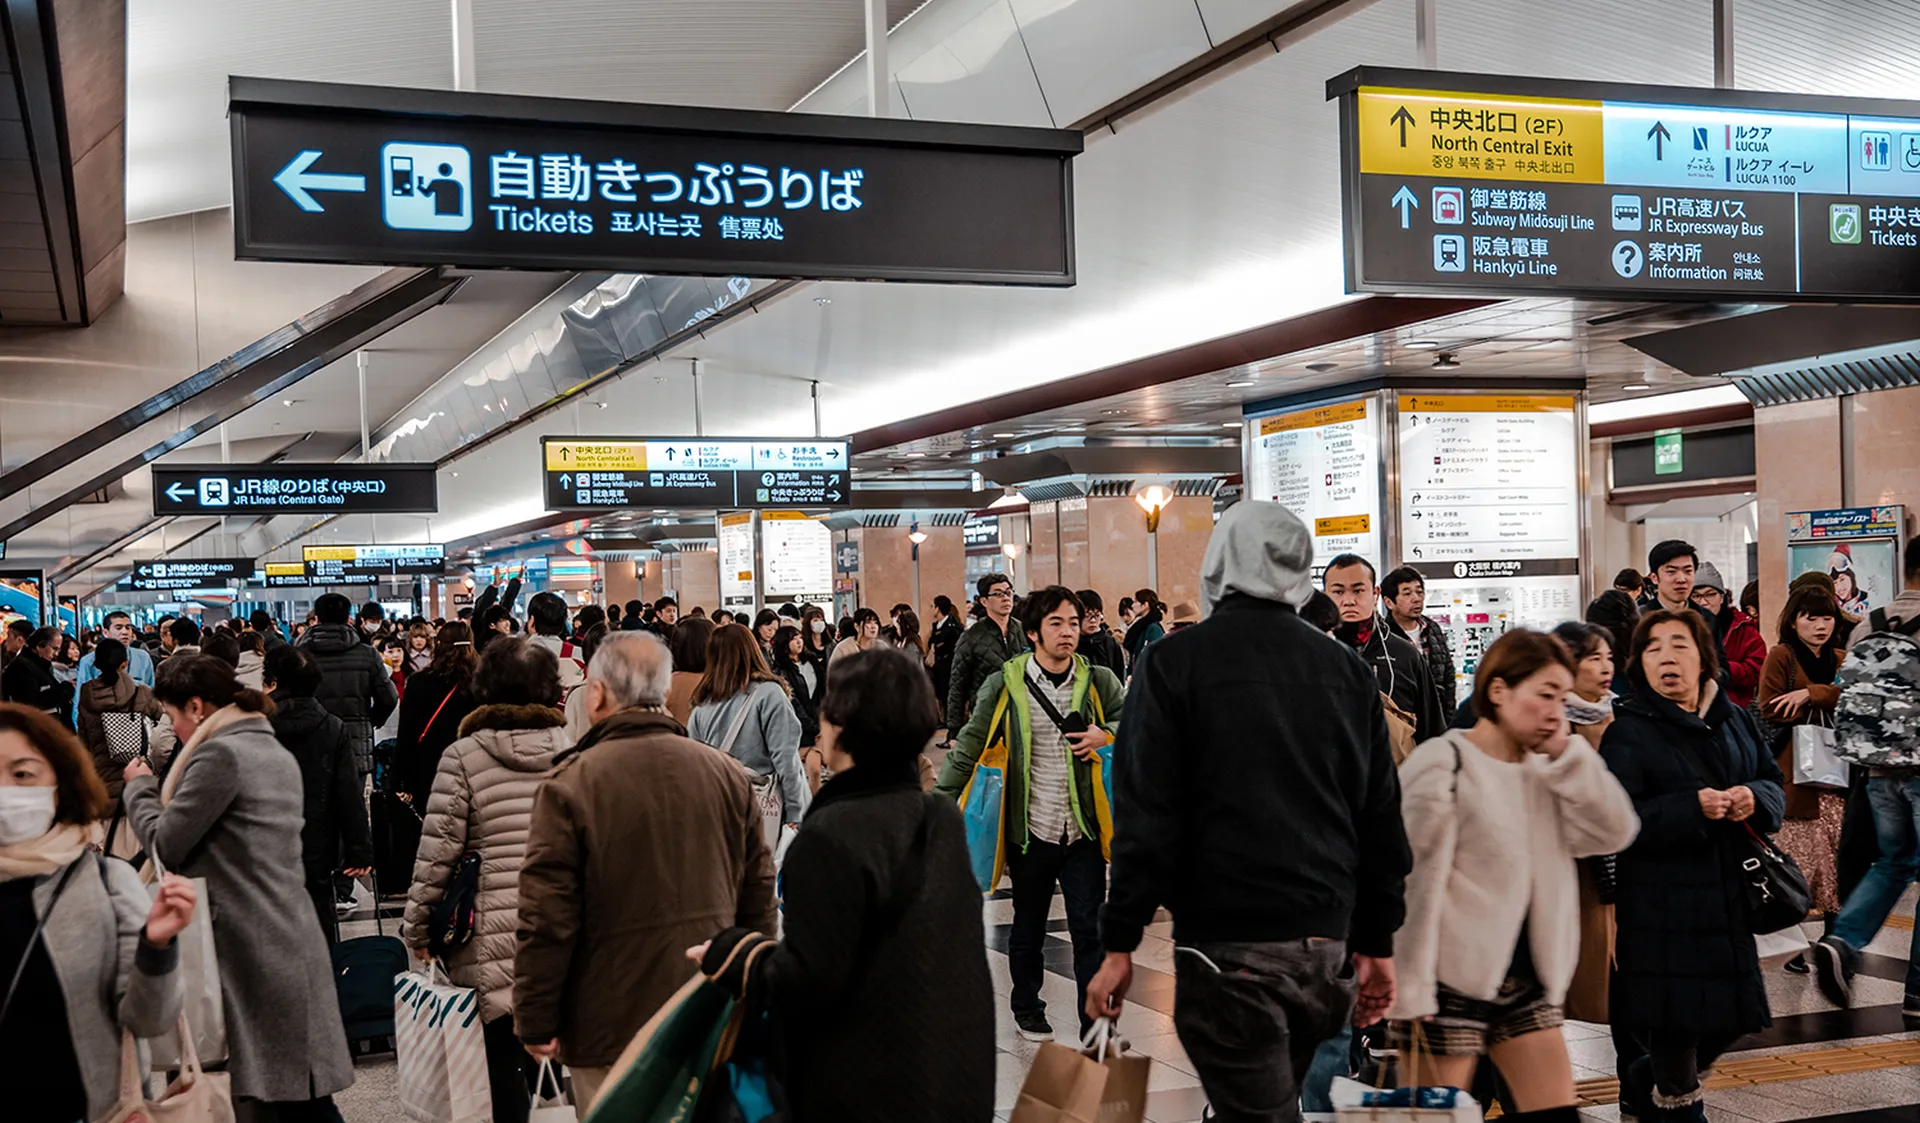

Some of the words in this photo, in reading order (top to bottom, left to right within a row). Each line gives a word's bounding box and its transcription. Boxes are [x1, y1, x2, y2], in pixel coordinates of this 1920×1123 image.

[1430, 107, 1517, 133] 中央北口
[1525, 116, 1564, 136] (2F)
[1735, 125, 1772, 140] ルクア
[1431, 135, 1478, 151] North
[1482, 138, 1539, 155] Central
[1544, 141, 1573, 156] Exit
[1735, 141, 1770, 152] LUCUA
[1431, 155, 1454, 169] 중앙
[1514, 159, 1575, 174] 中央北出口
[1736, 157, 1773, 171] ルクア
[1778, 161, 1815, 174] イーレ
[488, 150, 865, 211] 自動きっぷうりば
[1736, 173, 1770, 185] LUCUA
[1772, 174, 1796, 186] 1100
[1470, 187, 1547, 211] 御堂筋線
[1648, 197, 1747, 219] JR高速バス
[488, 204, 594, 235] Tickets
[610, 212, 702, 238] 표사는곳
[718, 215, 785, 241] 售票处
[1471, 210, 1516, 231] Subway
[1519, 213, 1568, 232] Midōsuji
[1570, 214, 1595, 231] Line
[1648, 219, 1663, 232] JR
[1666, 219, 1739, 239] Expressway
[1741, 221, 1764, 236] Bus
[1472, 236, 1549, 257] 阪急電車
[1869, 230, 1917, 246] Tickets
[1649, 243, 1702, 263] 案内所
[1733, 252, 1761, 265] 안내소
[1473, 259, 1526, 278] Hankyū
[1529, 260, 1558, 275] Line
[1649, 264, 1727, 280] Information
[233, 495, 248, 505] JR
[250, 495, 277, 504] Lines
